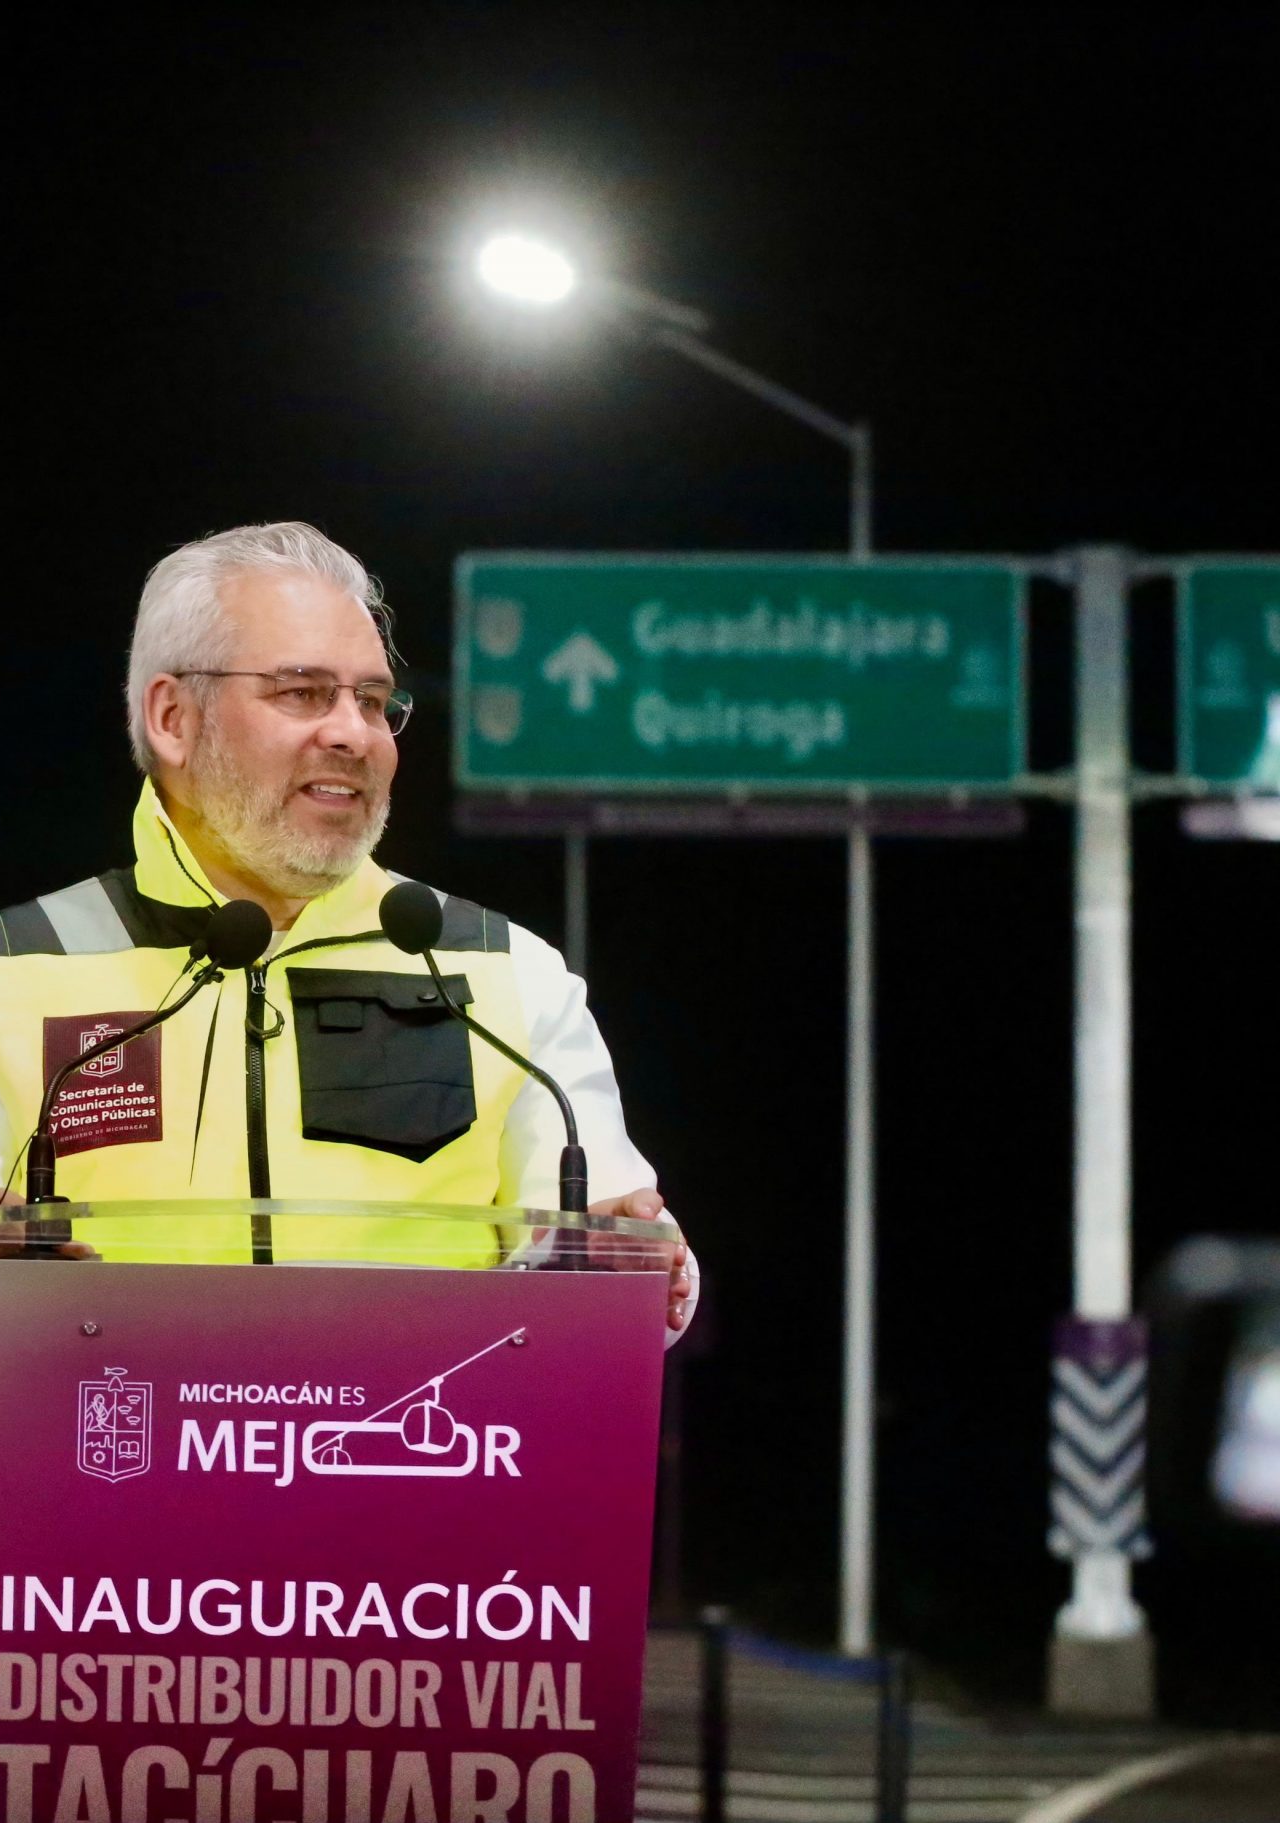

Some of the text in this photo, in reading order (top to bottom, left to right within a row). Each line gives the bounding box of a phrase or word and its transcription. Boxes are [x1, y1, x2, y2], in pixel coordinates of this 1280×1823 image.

[632, 600, 949, 668] Guadalajara
[632, 691, 846, 760] Quiroga
[50, 1095, 156, 1117] Comunicaciones
[50, 1106, 156, 1134] y Obras Públicas
[59, 1082, 145, 1102] Secretaría de
[178, 1381, 365, 1406] MICHOACÁN ES
[176, 1418, 523, 1487] MEJOR
[1, 1570, 592, 1641] INAUGURACIÓN
[461, 1660, 596, 1731] VIAL
